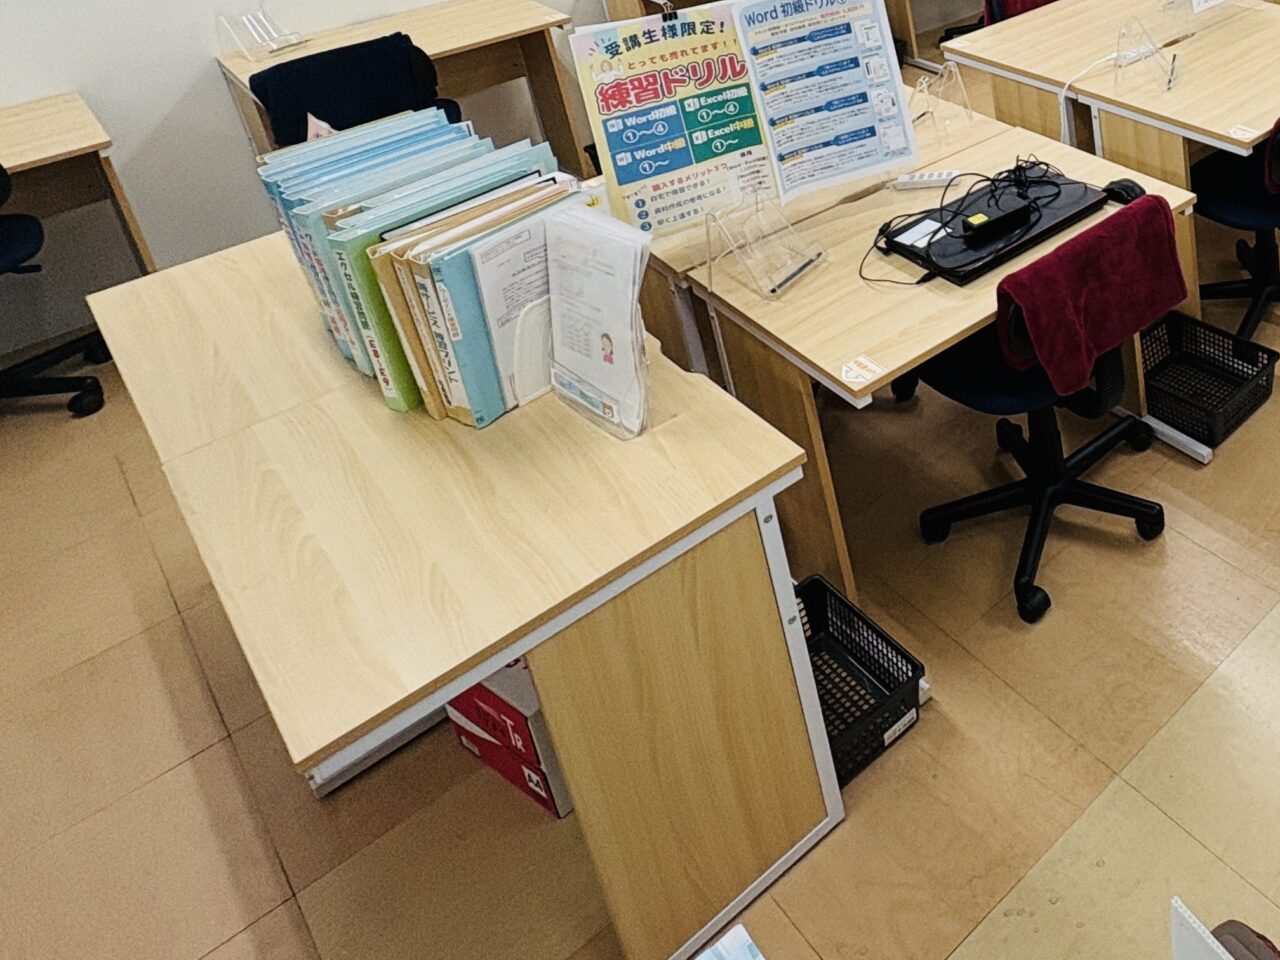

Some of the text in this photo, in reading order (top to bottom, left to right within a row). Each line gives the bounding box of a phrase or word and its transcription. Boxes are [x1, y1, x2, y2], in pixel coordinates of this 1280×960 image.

[744, 5, 779, 27] Word
[604, 20, 725, 59] 受講生様限定!
[596, 54, 749, 115] 練習ドリル
[701, 86, 748, 106] Excel初級
[625, 105, 678, 127] Word初級
[708, 118, 754, 138] Excel中級
[633, 138, 686, 160] Word中級
